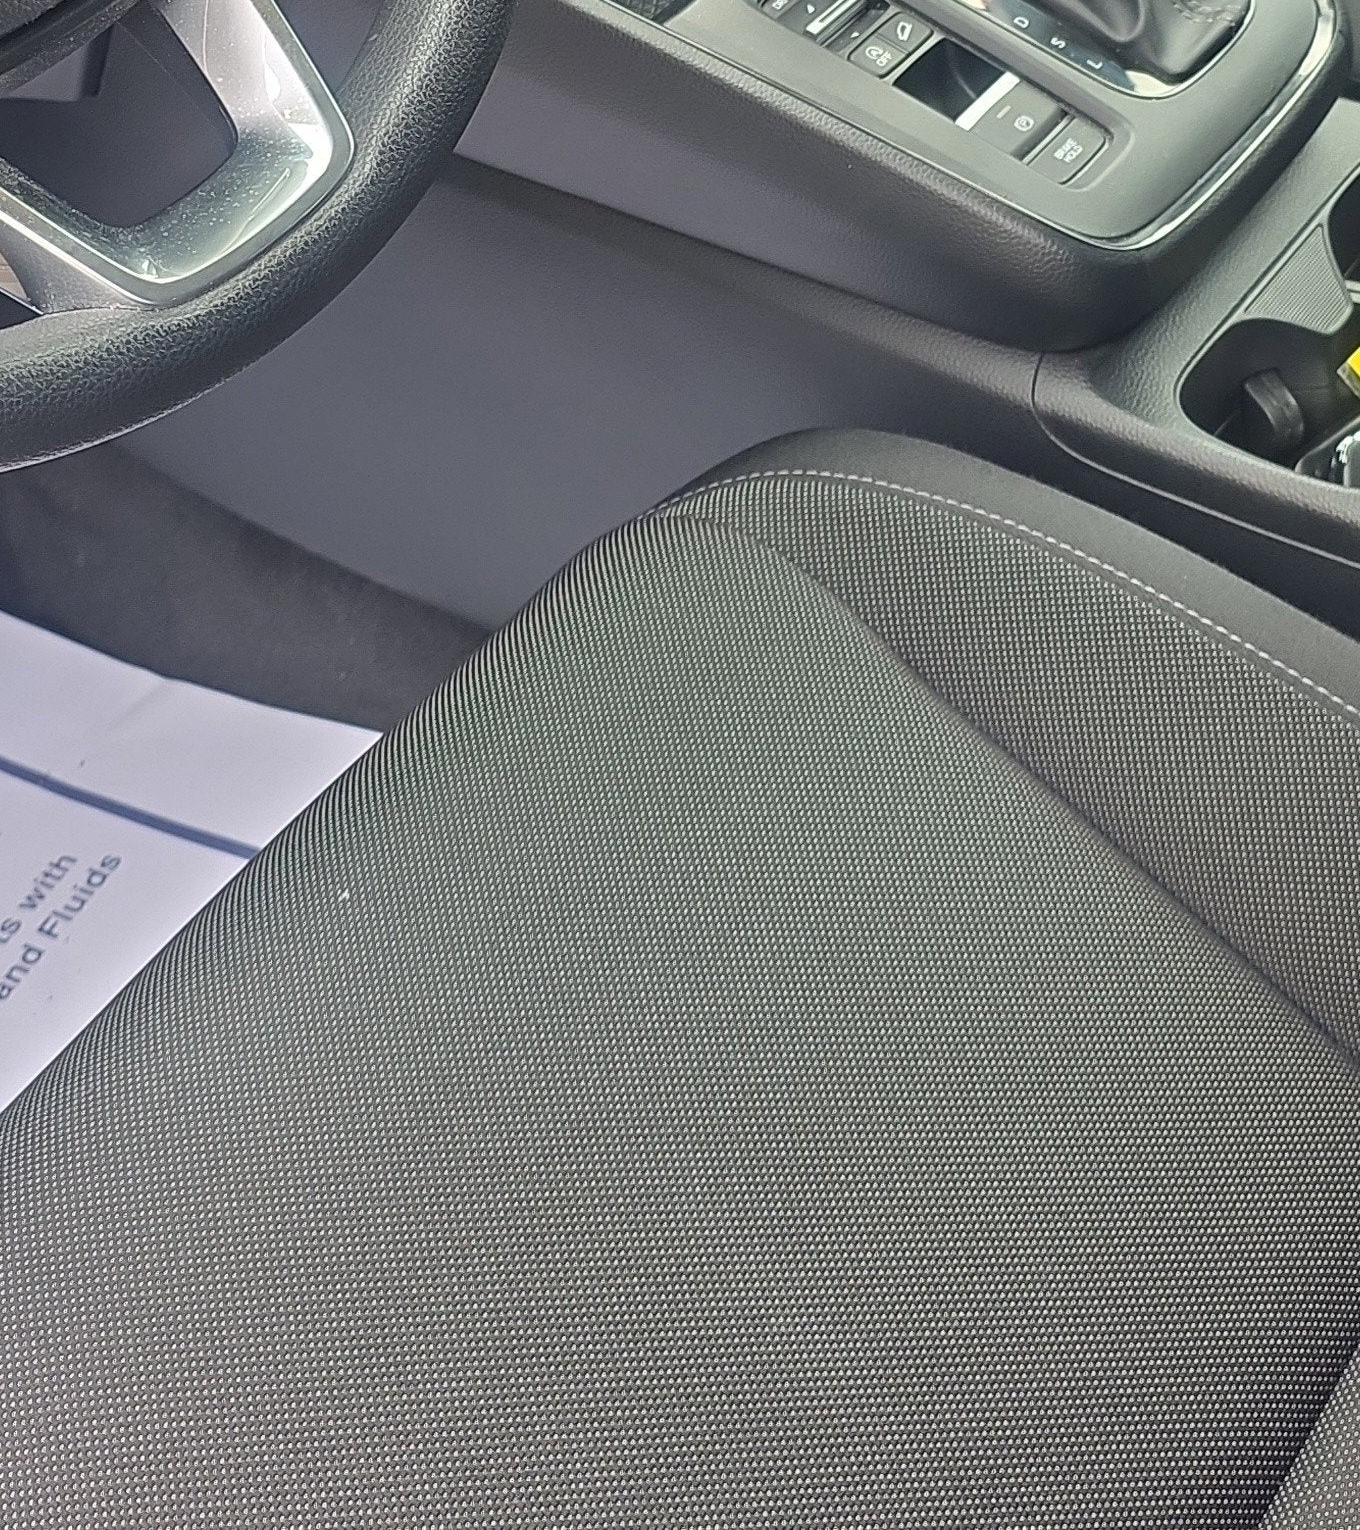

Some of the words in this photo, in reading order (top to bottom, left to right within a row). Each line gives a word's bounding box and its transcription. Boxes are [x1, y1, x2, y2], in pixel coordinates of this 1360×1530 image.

[1013, 16, 1030, 29] D
[1051, 37, 1067, 49] S
[1086, 59, 1104, 70] L
[19, 854, 78, 910] with
[38, 854, 123, 939] Fluids
